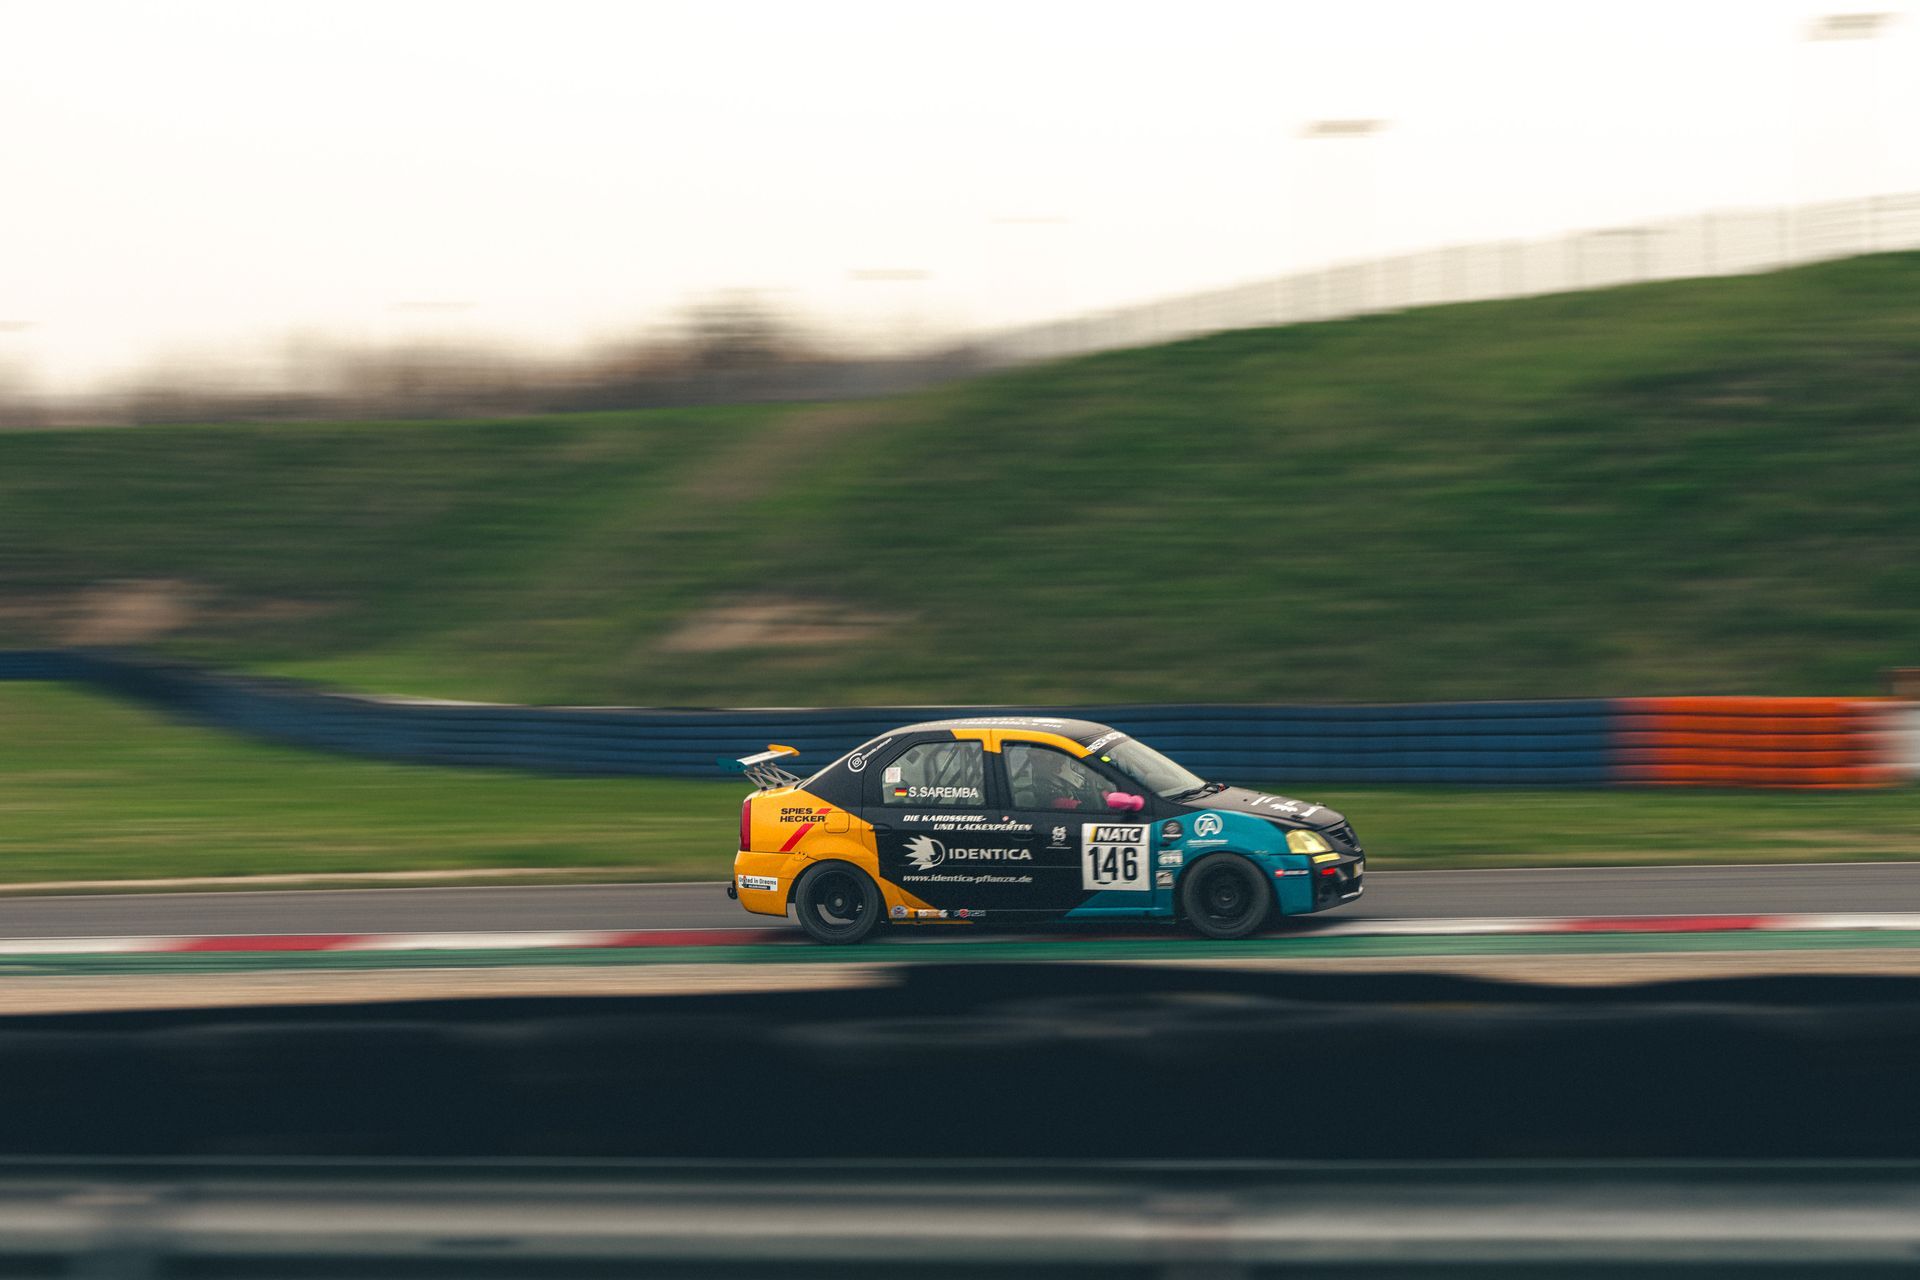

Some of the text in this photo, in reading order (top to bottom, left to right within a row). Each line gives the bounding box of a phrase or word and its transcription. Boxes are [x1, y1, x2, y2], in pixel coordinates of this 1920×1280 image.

[908, 786, 979, 798] S.SAREMBA
[780, 807, 813, 815] SPIES
[779, 815, 826, 823] HECKER
[921, 815, 987, 823] KAROSSERIE-
[933, 823, 1033, 832] UND LACKEXPERTEN
[1095, 827, 1142, 842] NATC
[948, 848, 1033, 861] IDENTICA
[1088, 846, 1138, 881] 146
[903, 874, 1033, 884] www.identica-pflanze.de
